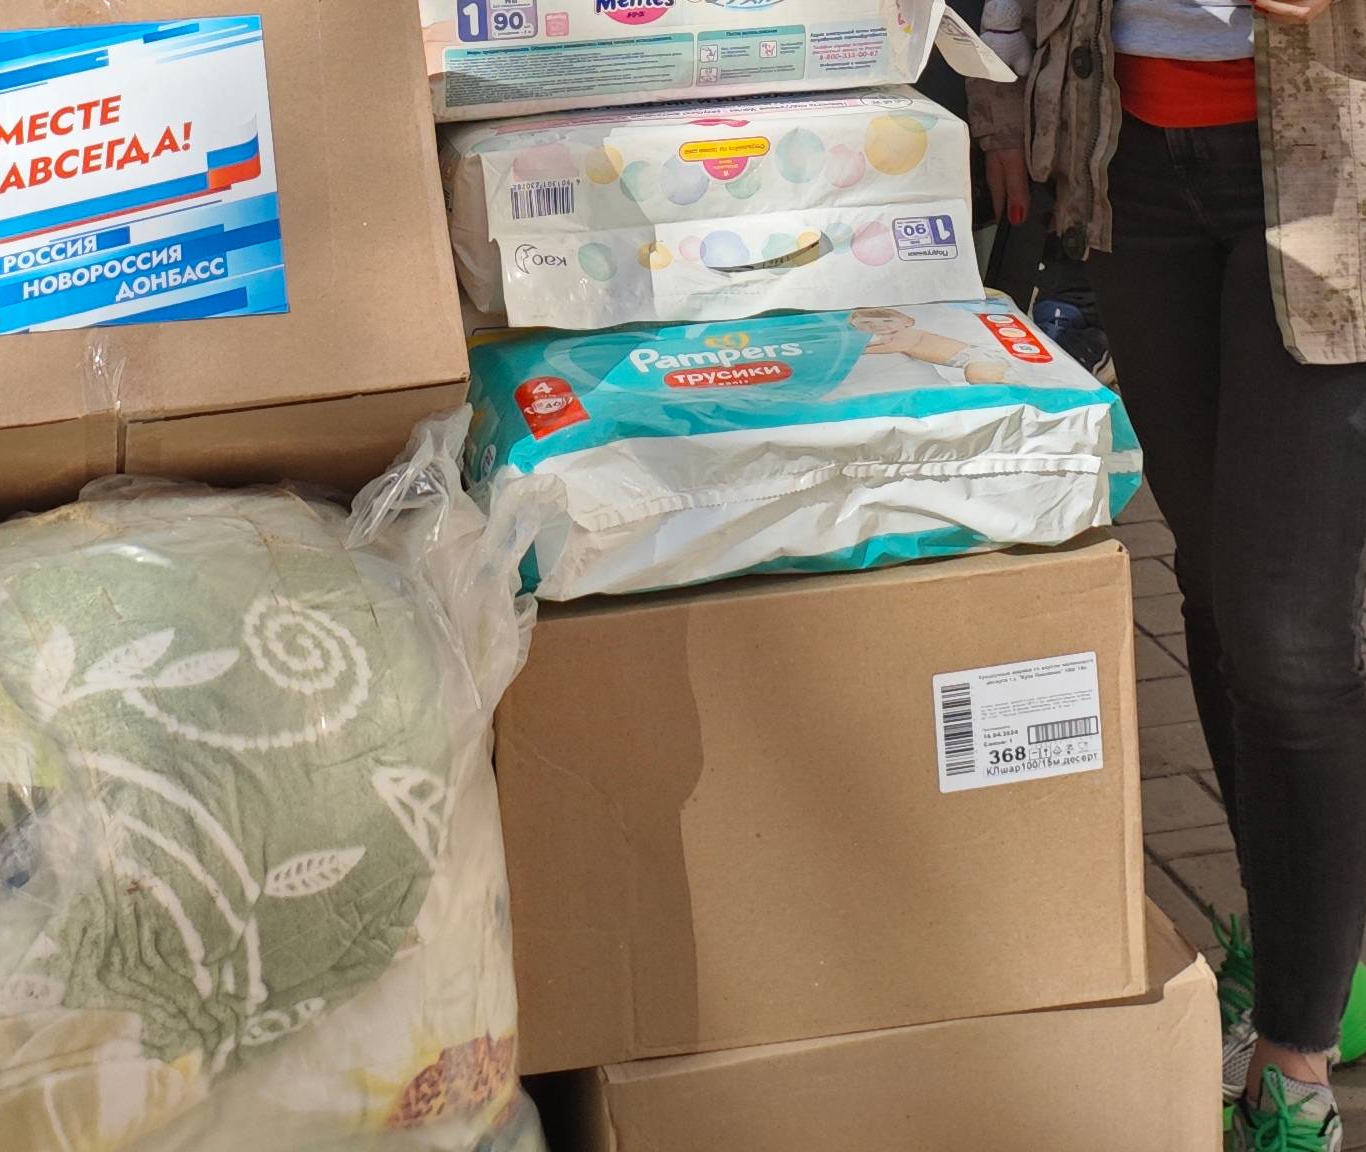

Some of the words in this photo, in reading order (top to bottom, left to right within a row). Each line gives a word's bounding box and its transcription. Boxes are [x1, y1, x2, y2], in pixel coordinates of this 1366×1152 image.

[462, 1, 480, 37] 1
[493, 11, 524, 31] 90
[903, 223, 927, 237] 90
[935, 217, 952, 241] 1
[3, 234, 98, 274] РОССИЯ
[531, 253, 567, 266] kao
[22, 244, 183, 300] НОВОРОССИЯ
[115, 257, 225, 304] ДОНБАСС
[629, 342, 803, 374] Pampers
[673, 365, 781, 385] трусики
[531, 382, 553, 395] 4
[989, 746, 1026, 765] 368
